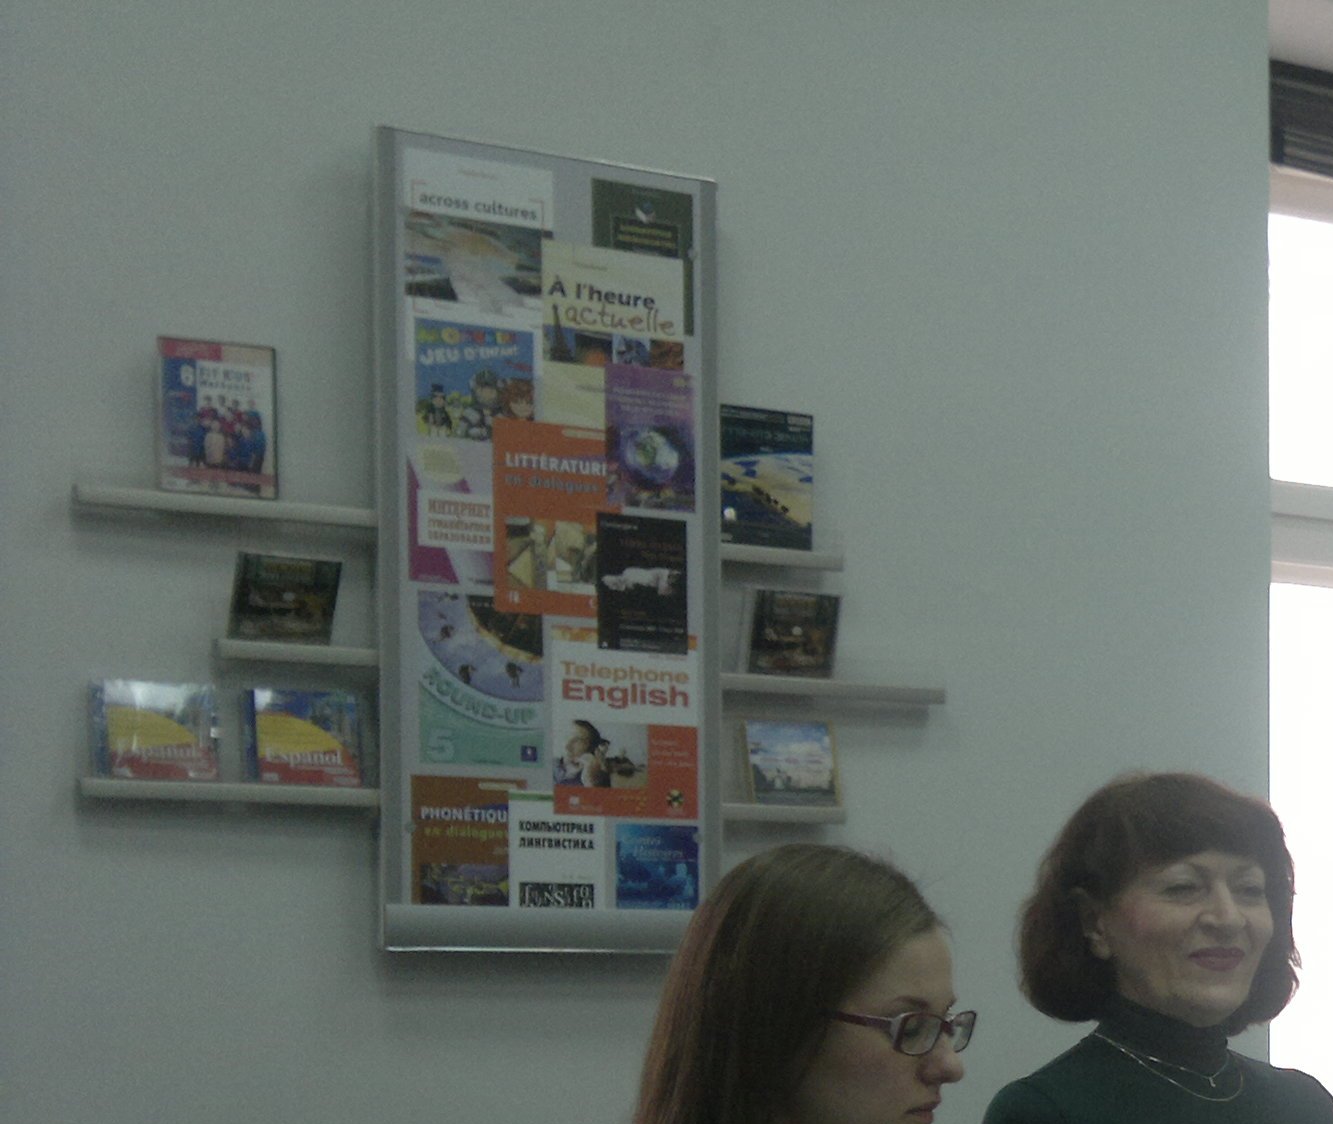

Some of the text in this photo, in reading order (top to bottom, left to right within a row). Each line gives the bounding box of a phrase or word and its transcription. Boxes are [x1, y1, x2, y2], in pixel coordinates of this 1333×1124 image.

[418, 193, 538, 221] across cultures
[575, 282, 656, 310] l'heure
[564, 303, 677, 337] actuelle
[561, 660, 690, 685] Telephone
[561, 679, 690, 710] English
[518, 820, 595, 835] КОМПЬЮТЕРНАЯ
[518, 837, 596, 851] ЛИНГВИСТИКА
